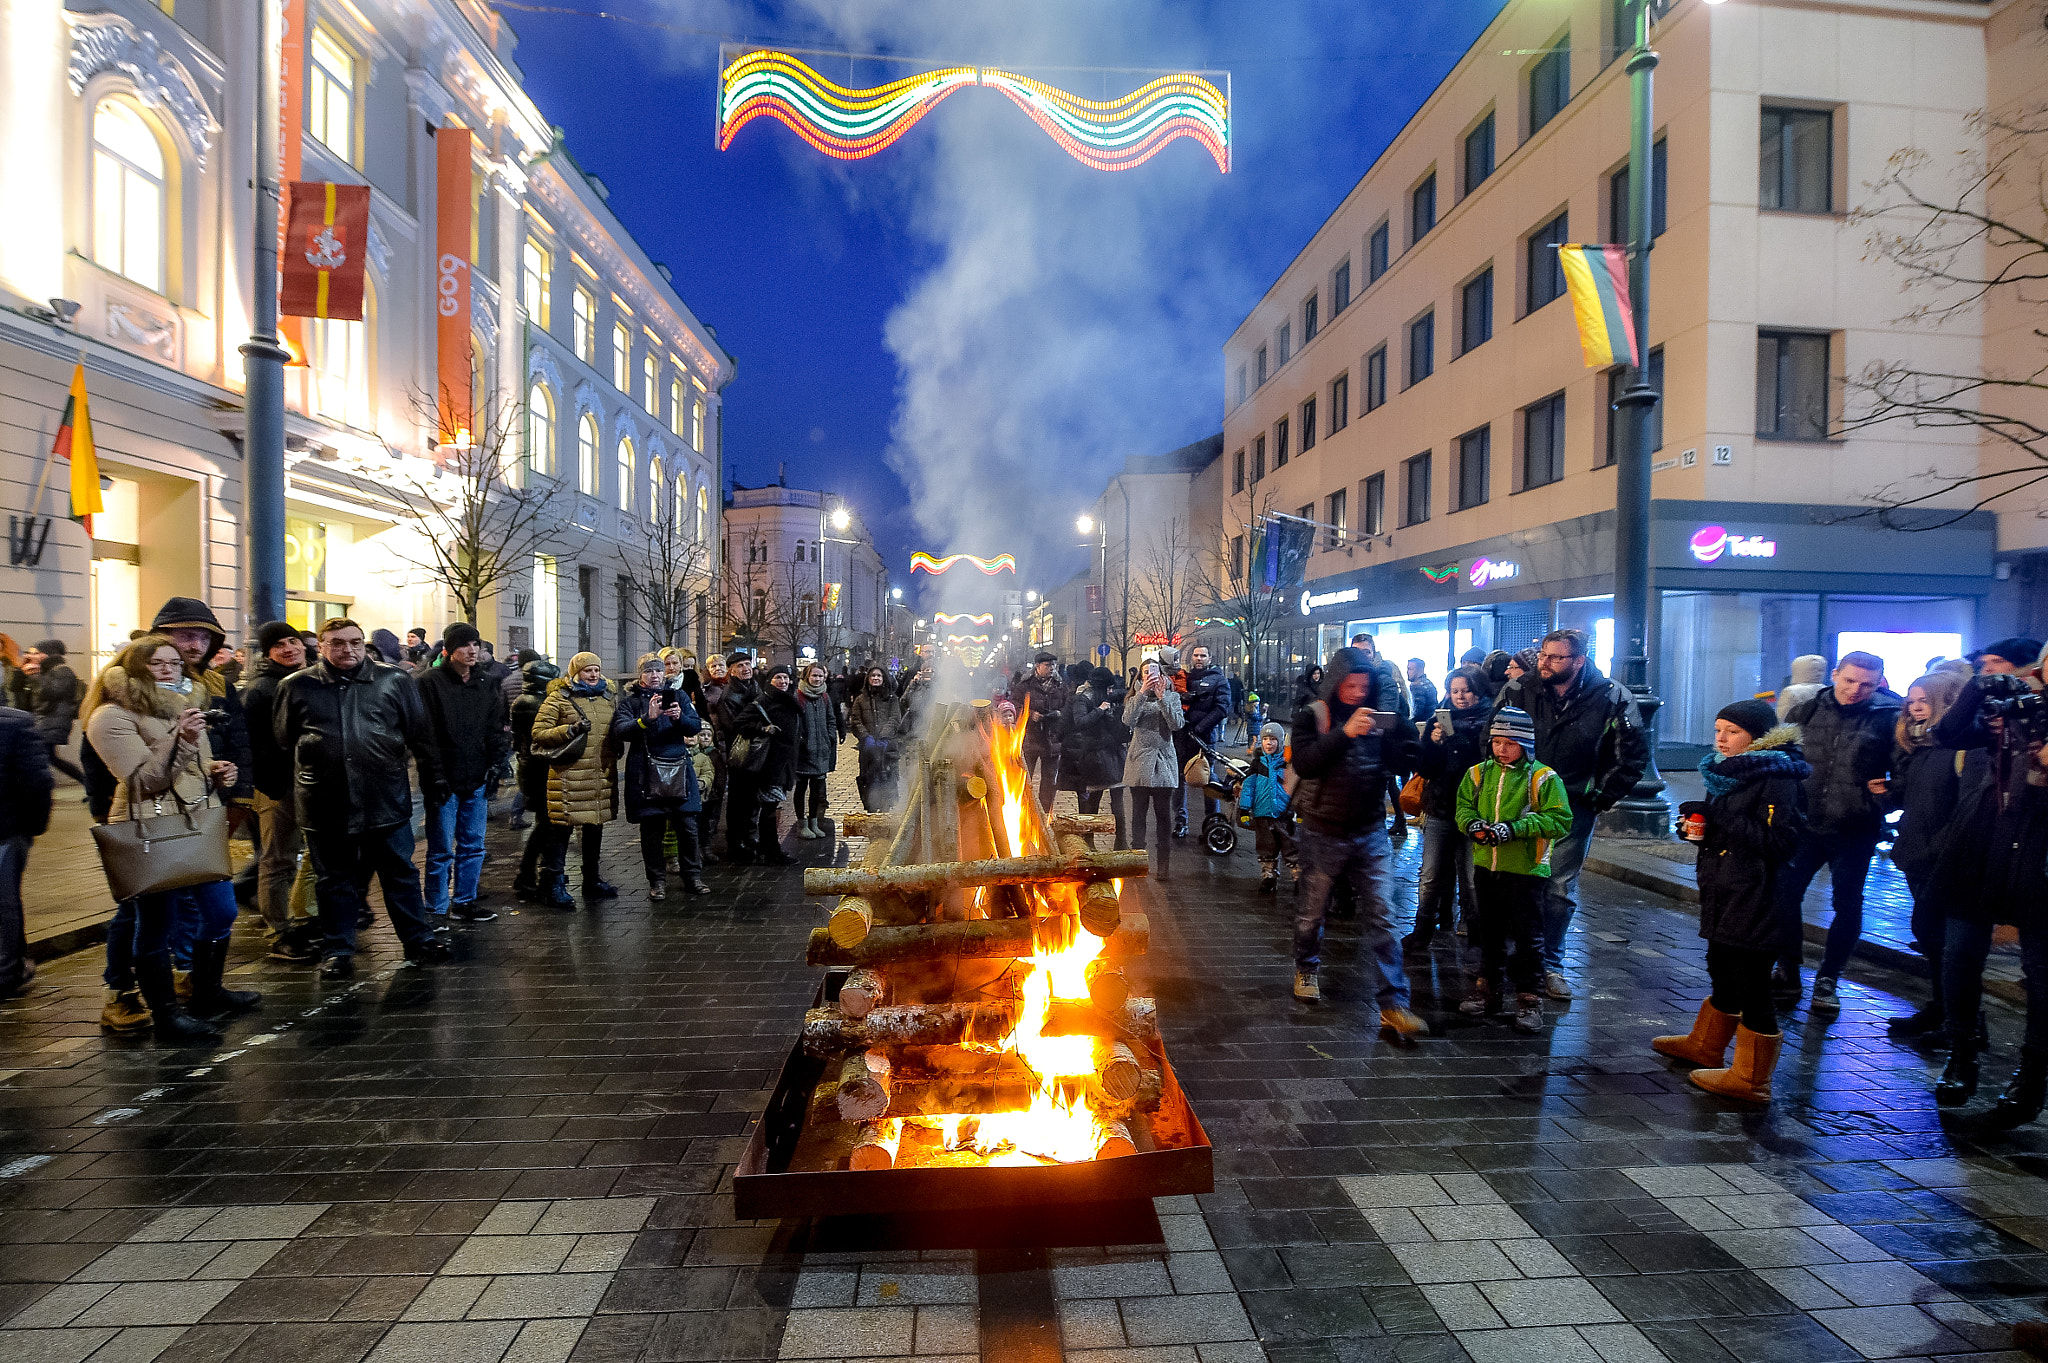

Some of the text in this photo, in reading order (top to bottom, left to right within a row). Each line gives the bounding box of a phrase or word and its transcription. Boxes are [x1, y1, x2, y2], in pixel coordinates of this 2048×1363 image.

[440, 253, 467, 317] GO9
[1684, 451, 1695, 465] 12
[1717, 447, 1729, 460] 12
